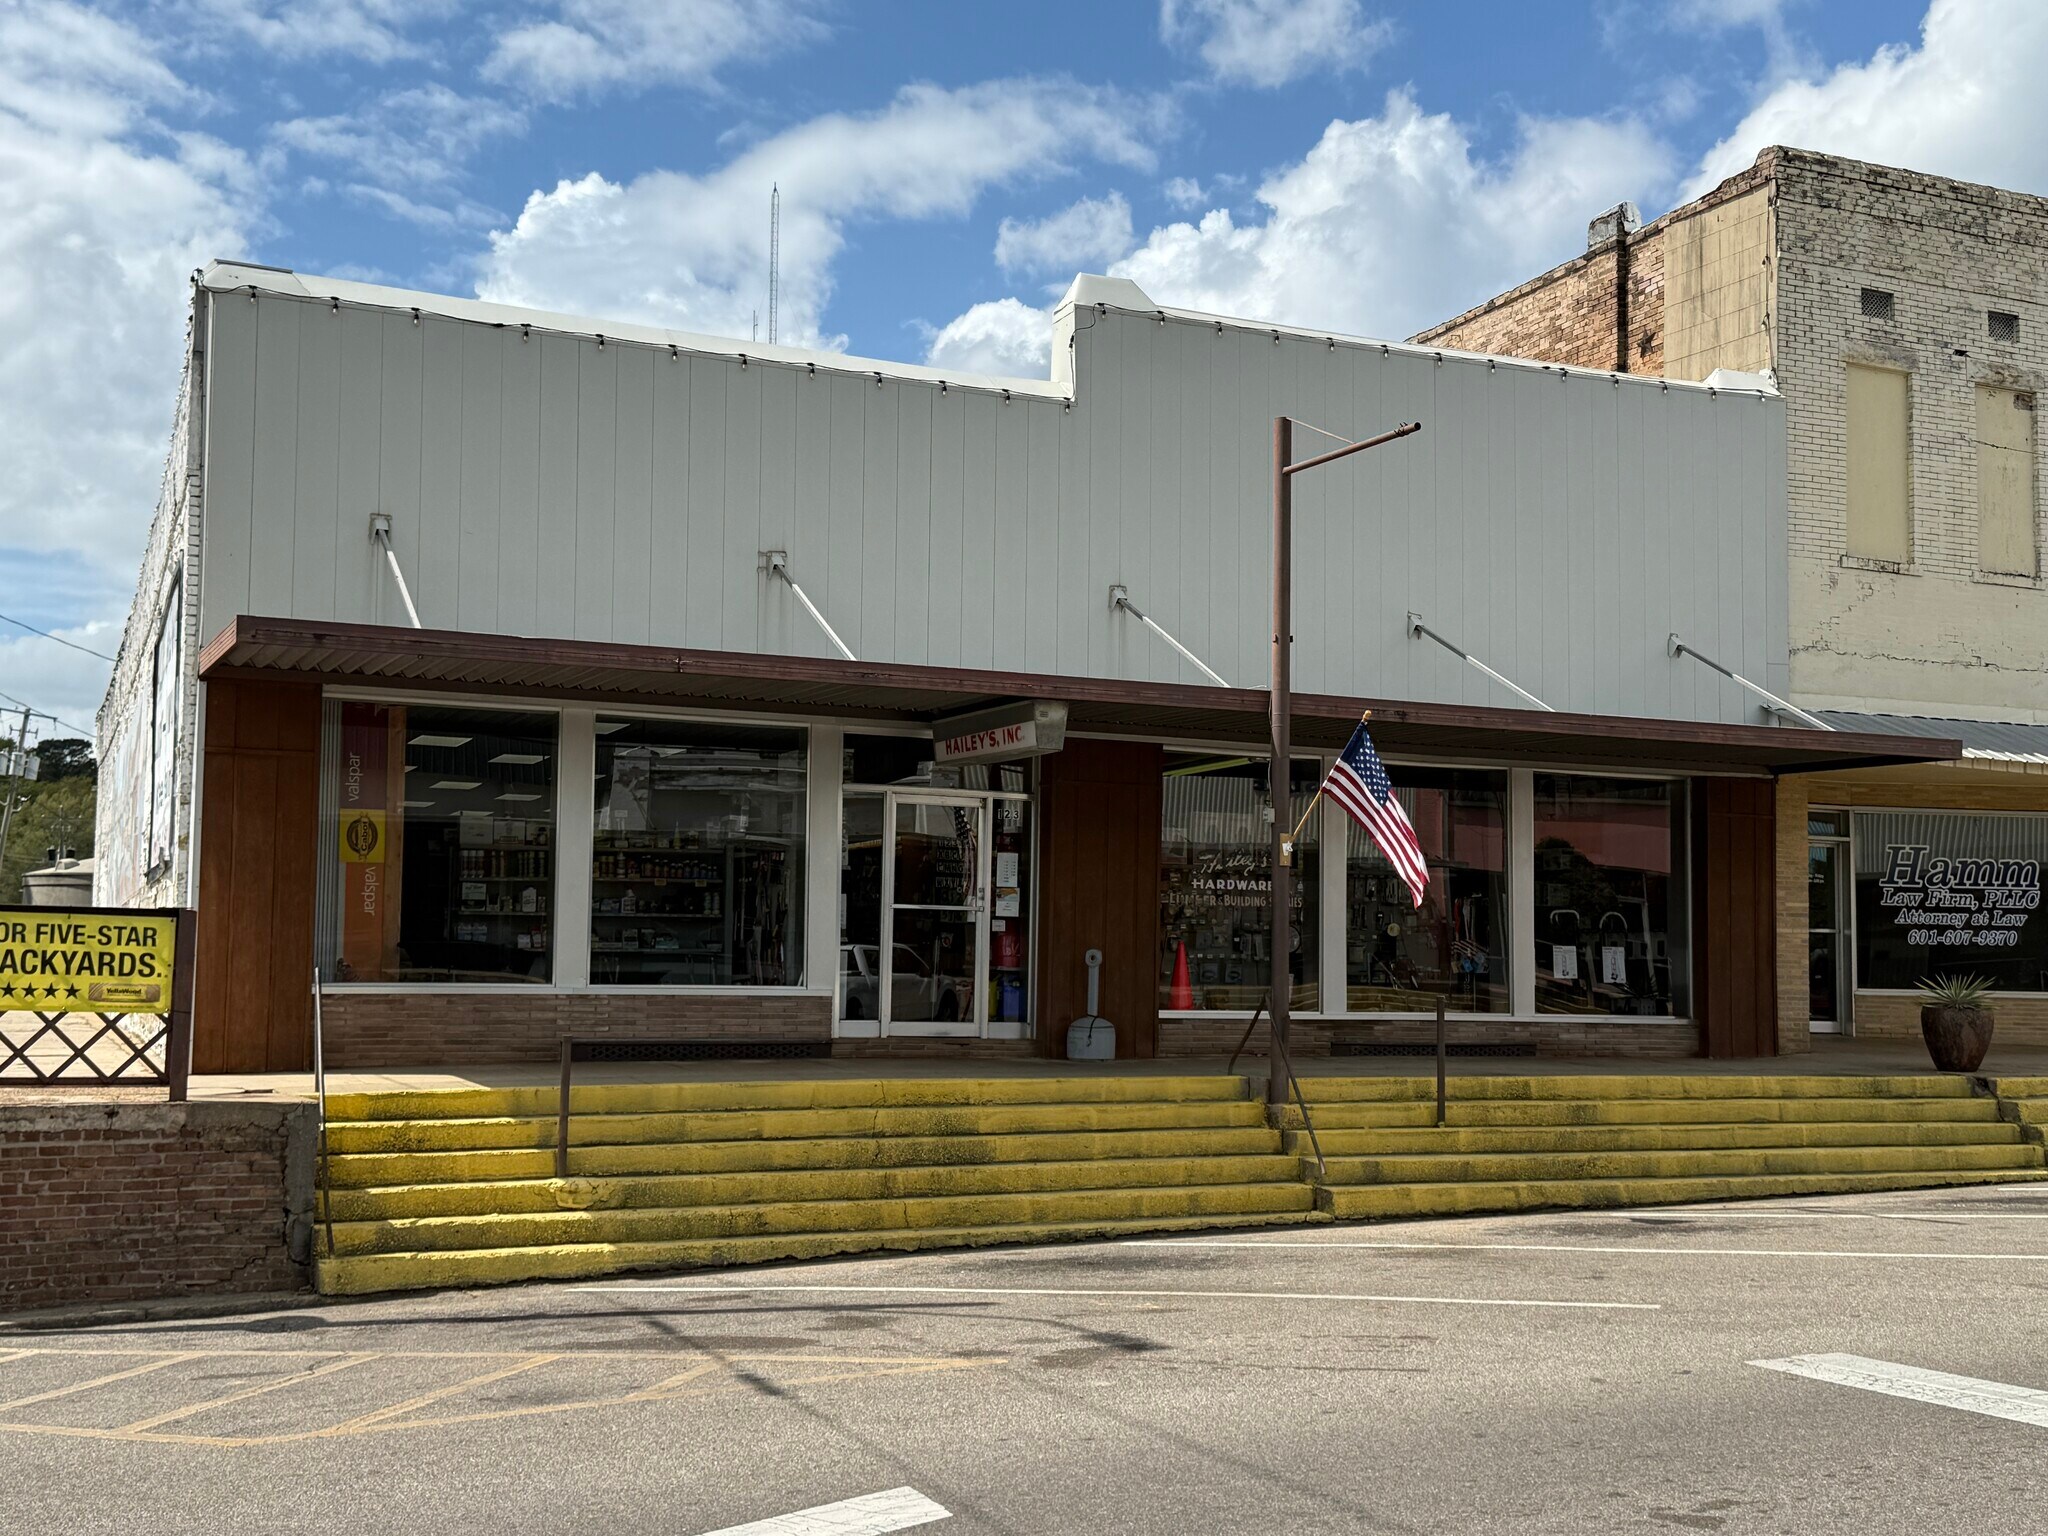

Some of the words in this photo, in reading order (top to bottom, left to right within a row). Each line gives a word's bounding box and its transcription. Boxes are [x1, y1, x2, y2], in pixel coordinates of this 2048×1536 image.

[345, 752, 364, 802] valspar
[1879, 844, 2040, 890] Hamm
[361, 866, 380, 917] valspar
[1223, 895, 1267, 908] BUILDING
[1880, 887, 1924, 907] Law
[1925, 889, 1979, 910] Firm,
[1982, 890, 2041, 909] PLLC
[1894, 907, 1969, 928] Attorney
[1971, 910, 1990, 926] at
[1991, 910, 2029, 927] Law
[36, 923, 157, 947] FIVE-STAR
[1908, 929, 2018, 946] 601-607-9370
